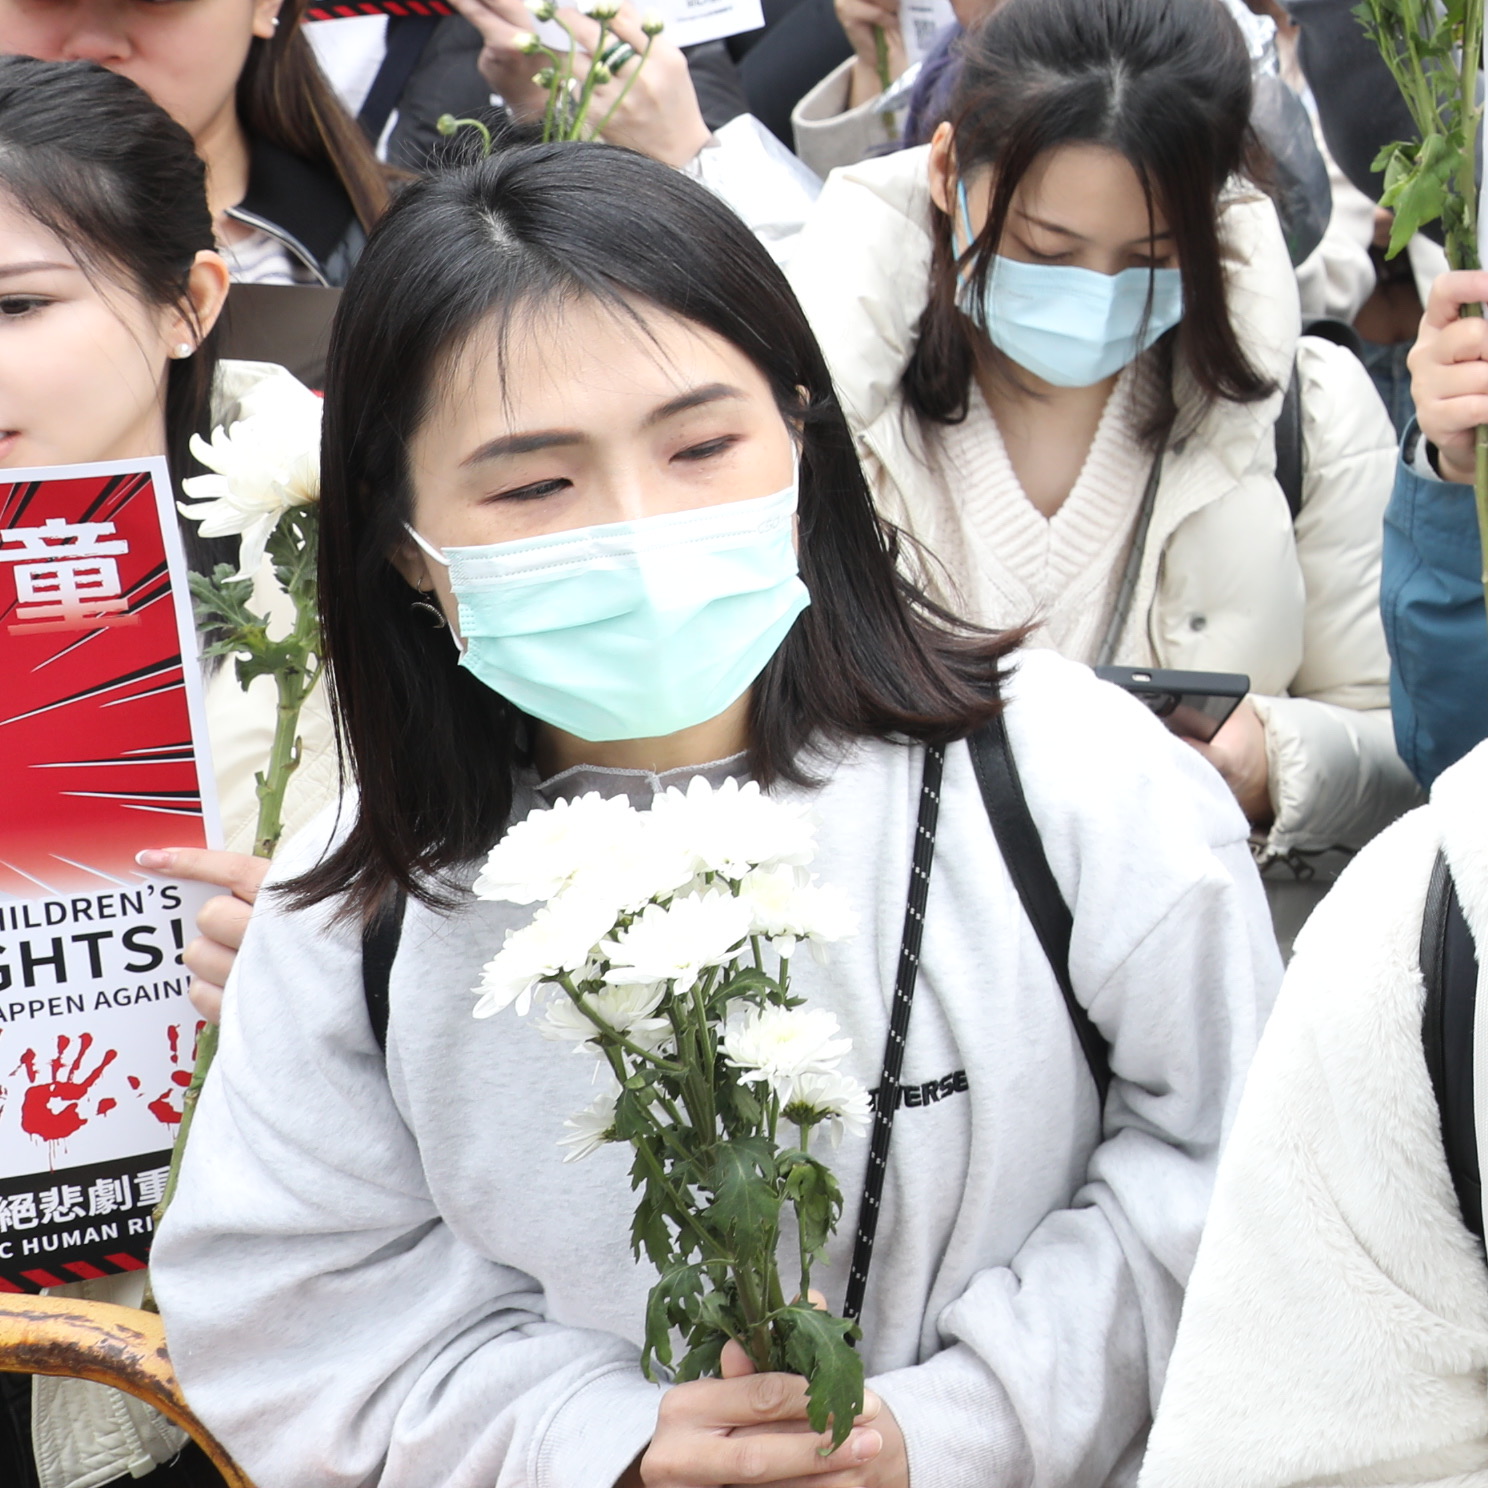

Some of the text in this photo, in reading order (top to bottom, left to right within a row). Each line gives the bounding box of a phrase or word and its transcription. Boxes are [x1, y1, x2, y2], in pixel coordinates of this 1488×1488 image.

[0, 517, 143, 637] 童
[94, 974, 192, 1011] AGAIN!
[868, 1068, 971, 1113] ERSE
[22, 1221, 119, 1257] HUMAN
